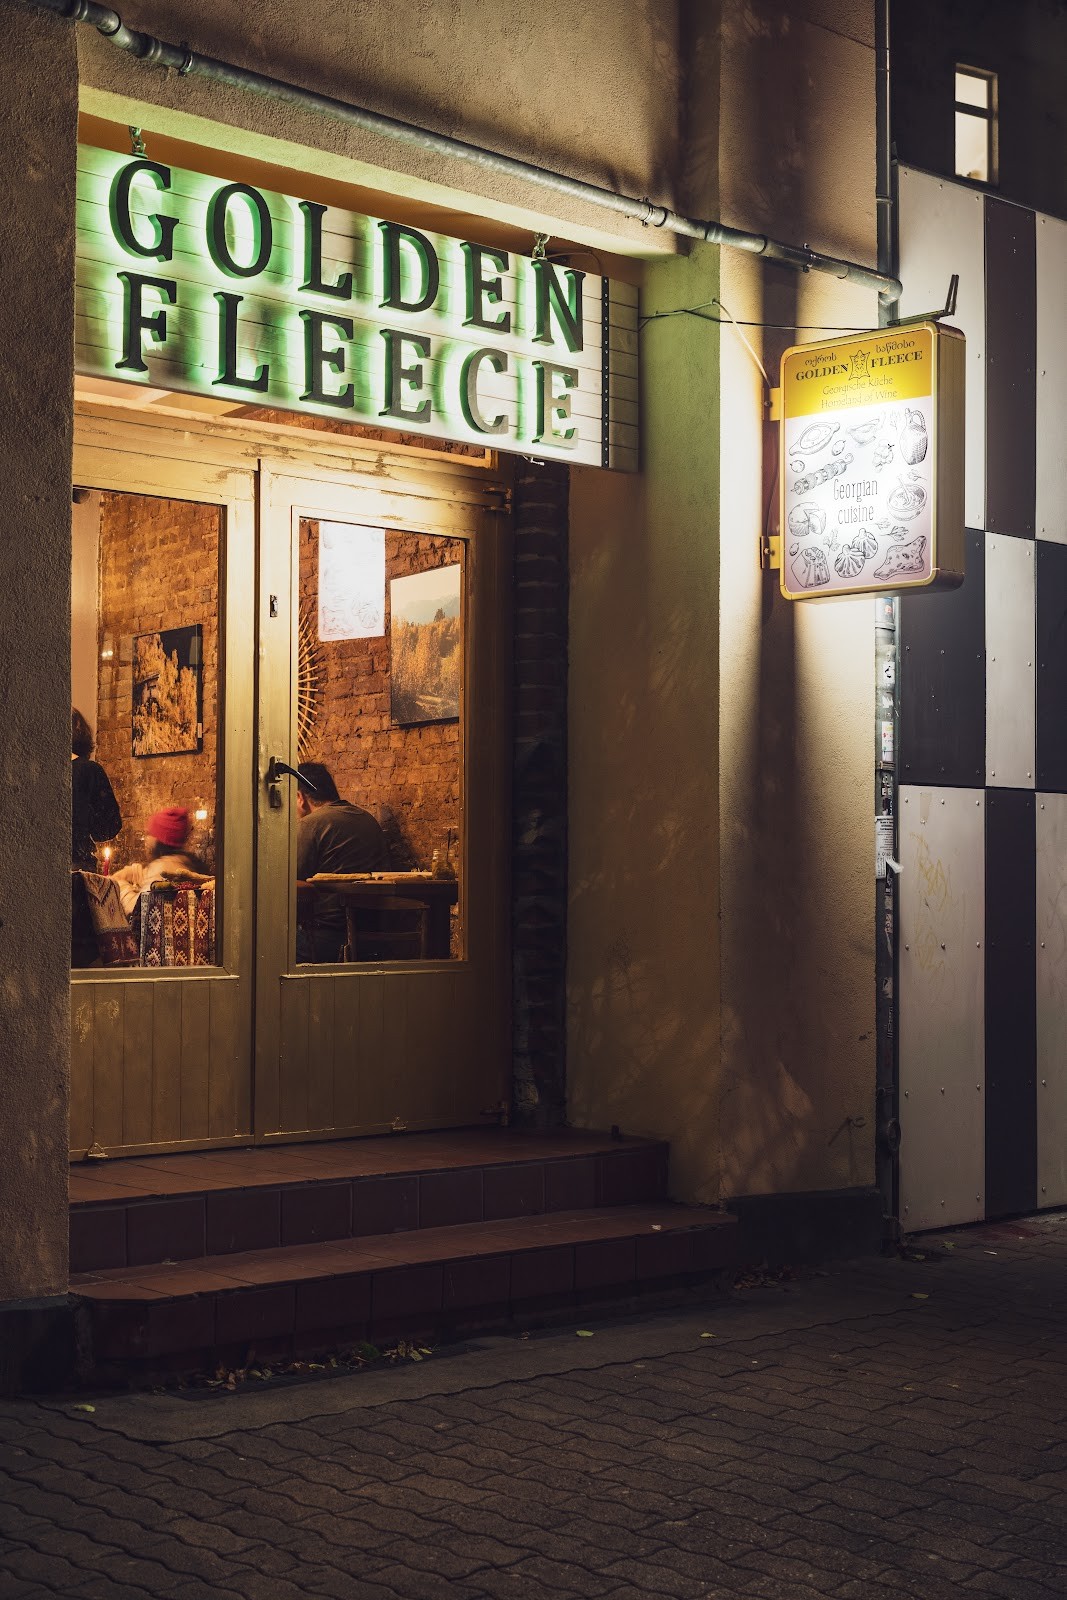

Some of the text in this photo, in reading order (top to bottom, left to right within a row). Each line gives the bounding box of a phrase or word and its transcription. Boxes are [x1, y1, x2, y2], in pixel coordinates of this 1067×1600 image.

[109, 159, 586, 353] GOLDEN
[114, 270, 580, 449] FLEECE
[795, 350, 923, 381] GOLDEN FLEECE
[822, 374, 894, 396] Georgische Küche
[821, 392, 862, 409] Homeland
[875, 389, 898, 400] Wine
[833, 478, 879, 502] Georgian
[837, 505, 875, 525] cuisine
